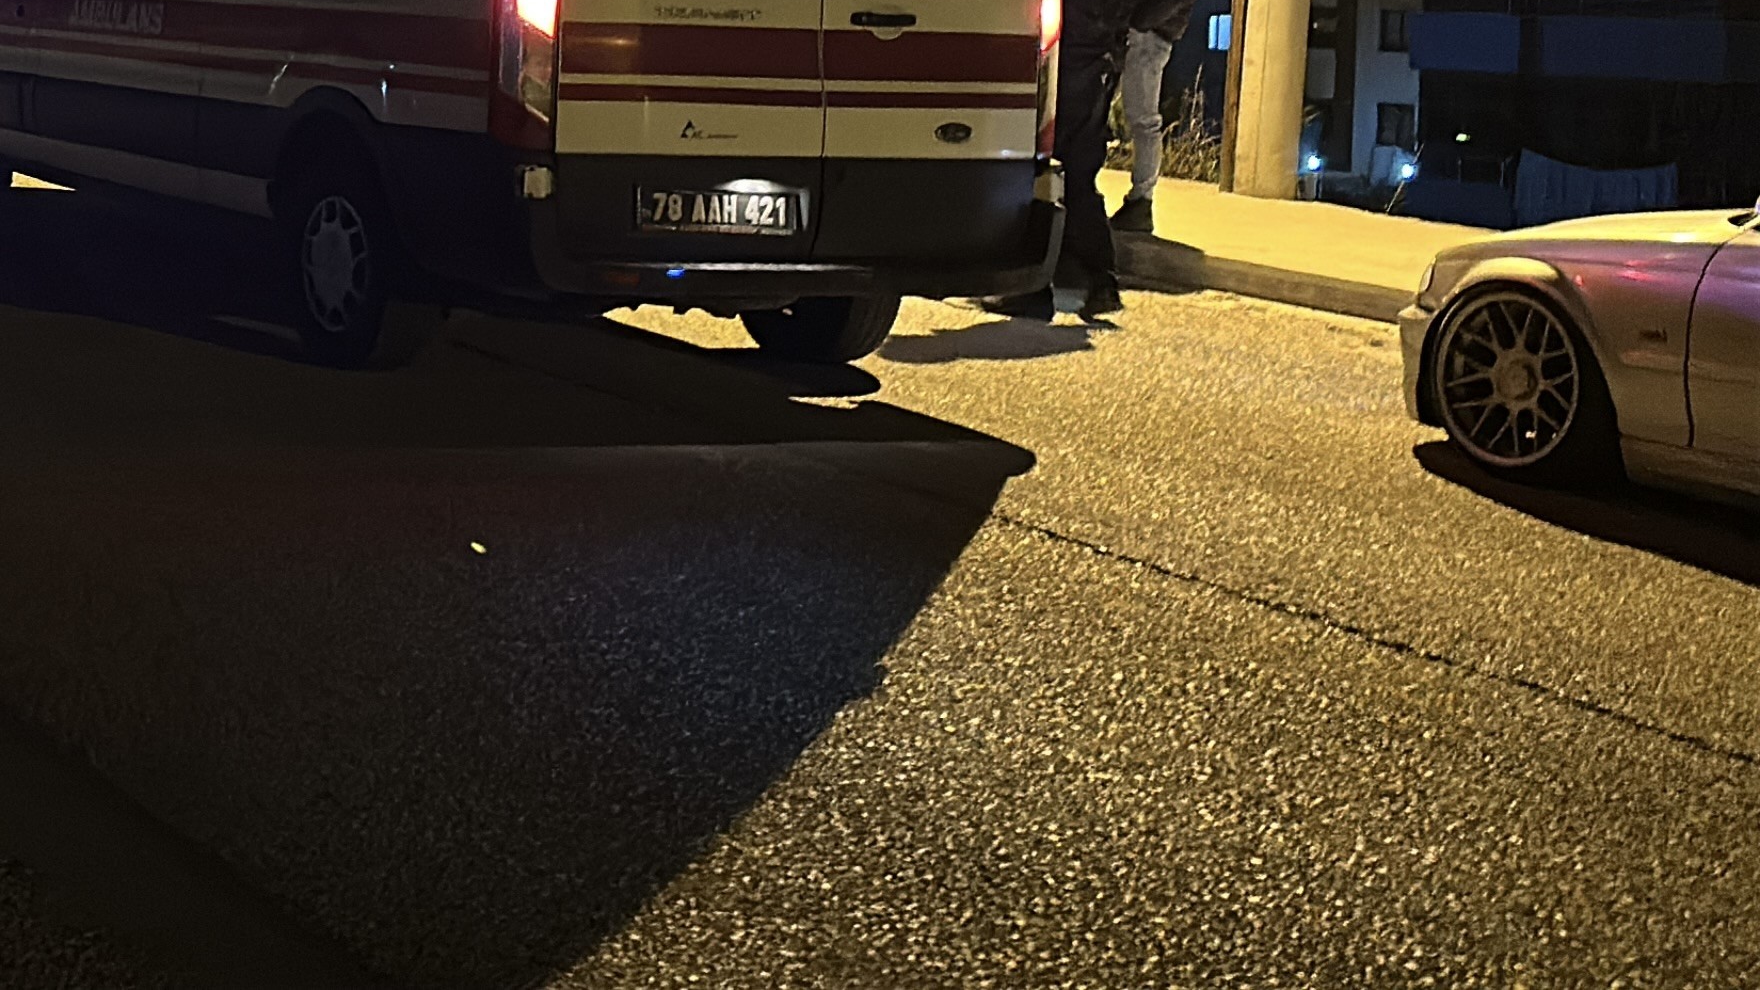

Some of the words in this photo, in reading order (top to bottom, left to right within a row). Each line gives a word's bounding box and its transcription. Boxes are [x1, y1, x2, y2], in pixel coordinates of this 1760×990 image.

[652, 192, 684, 223] 78
[691, 194, 738, 224] AAH
[744, 194, 787, 227] 421
